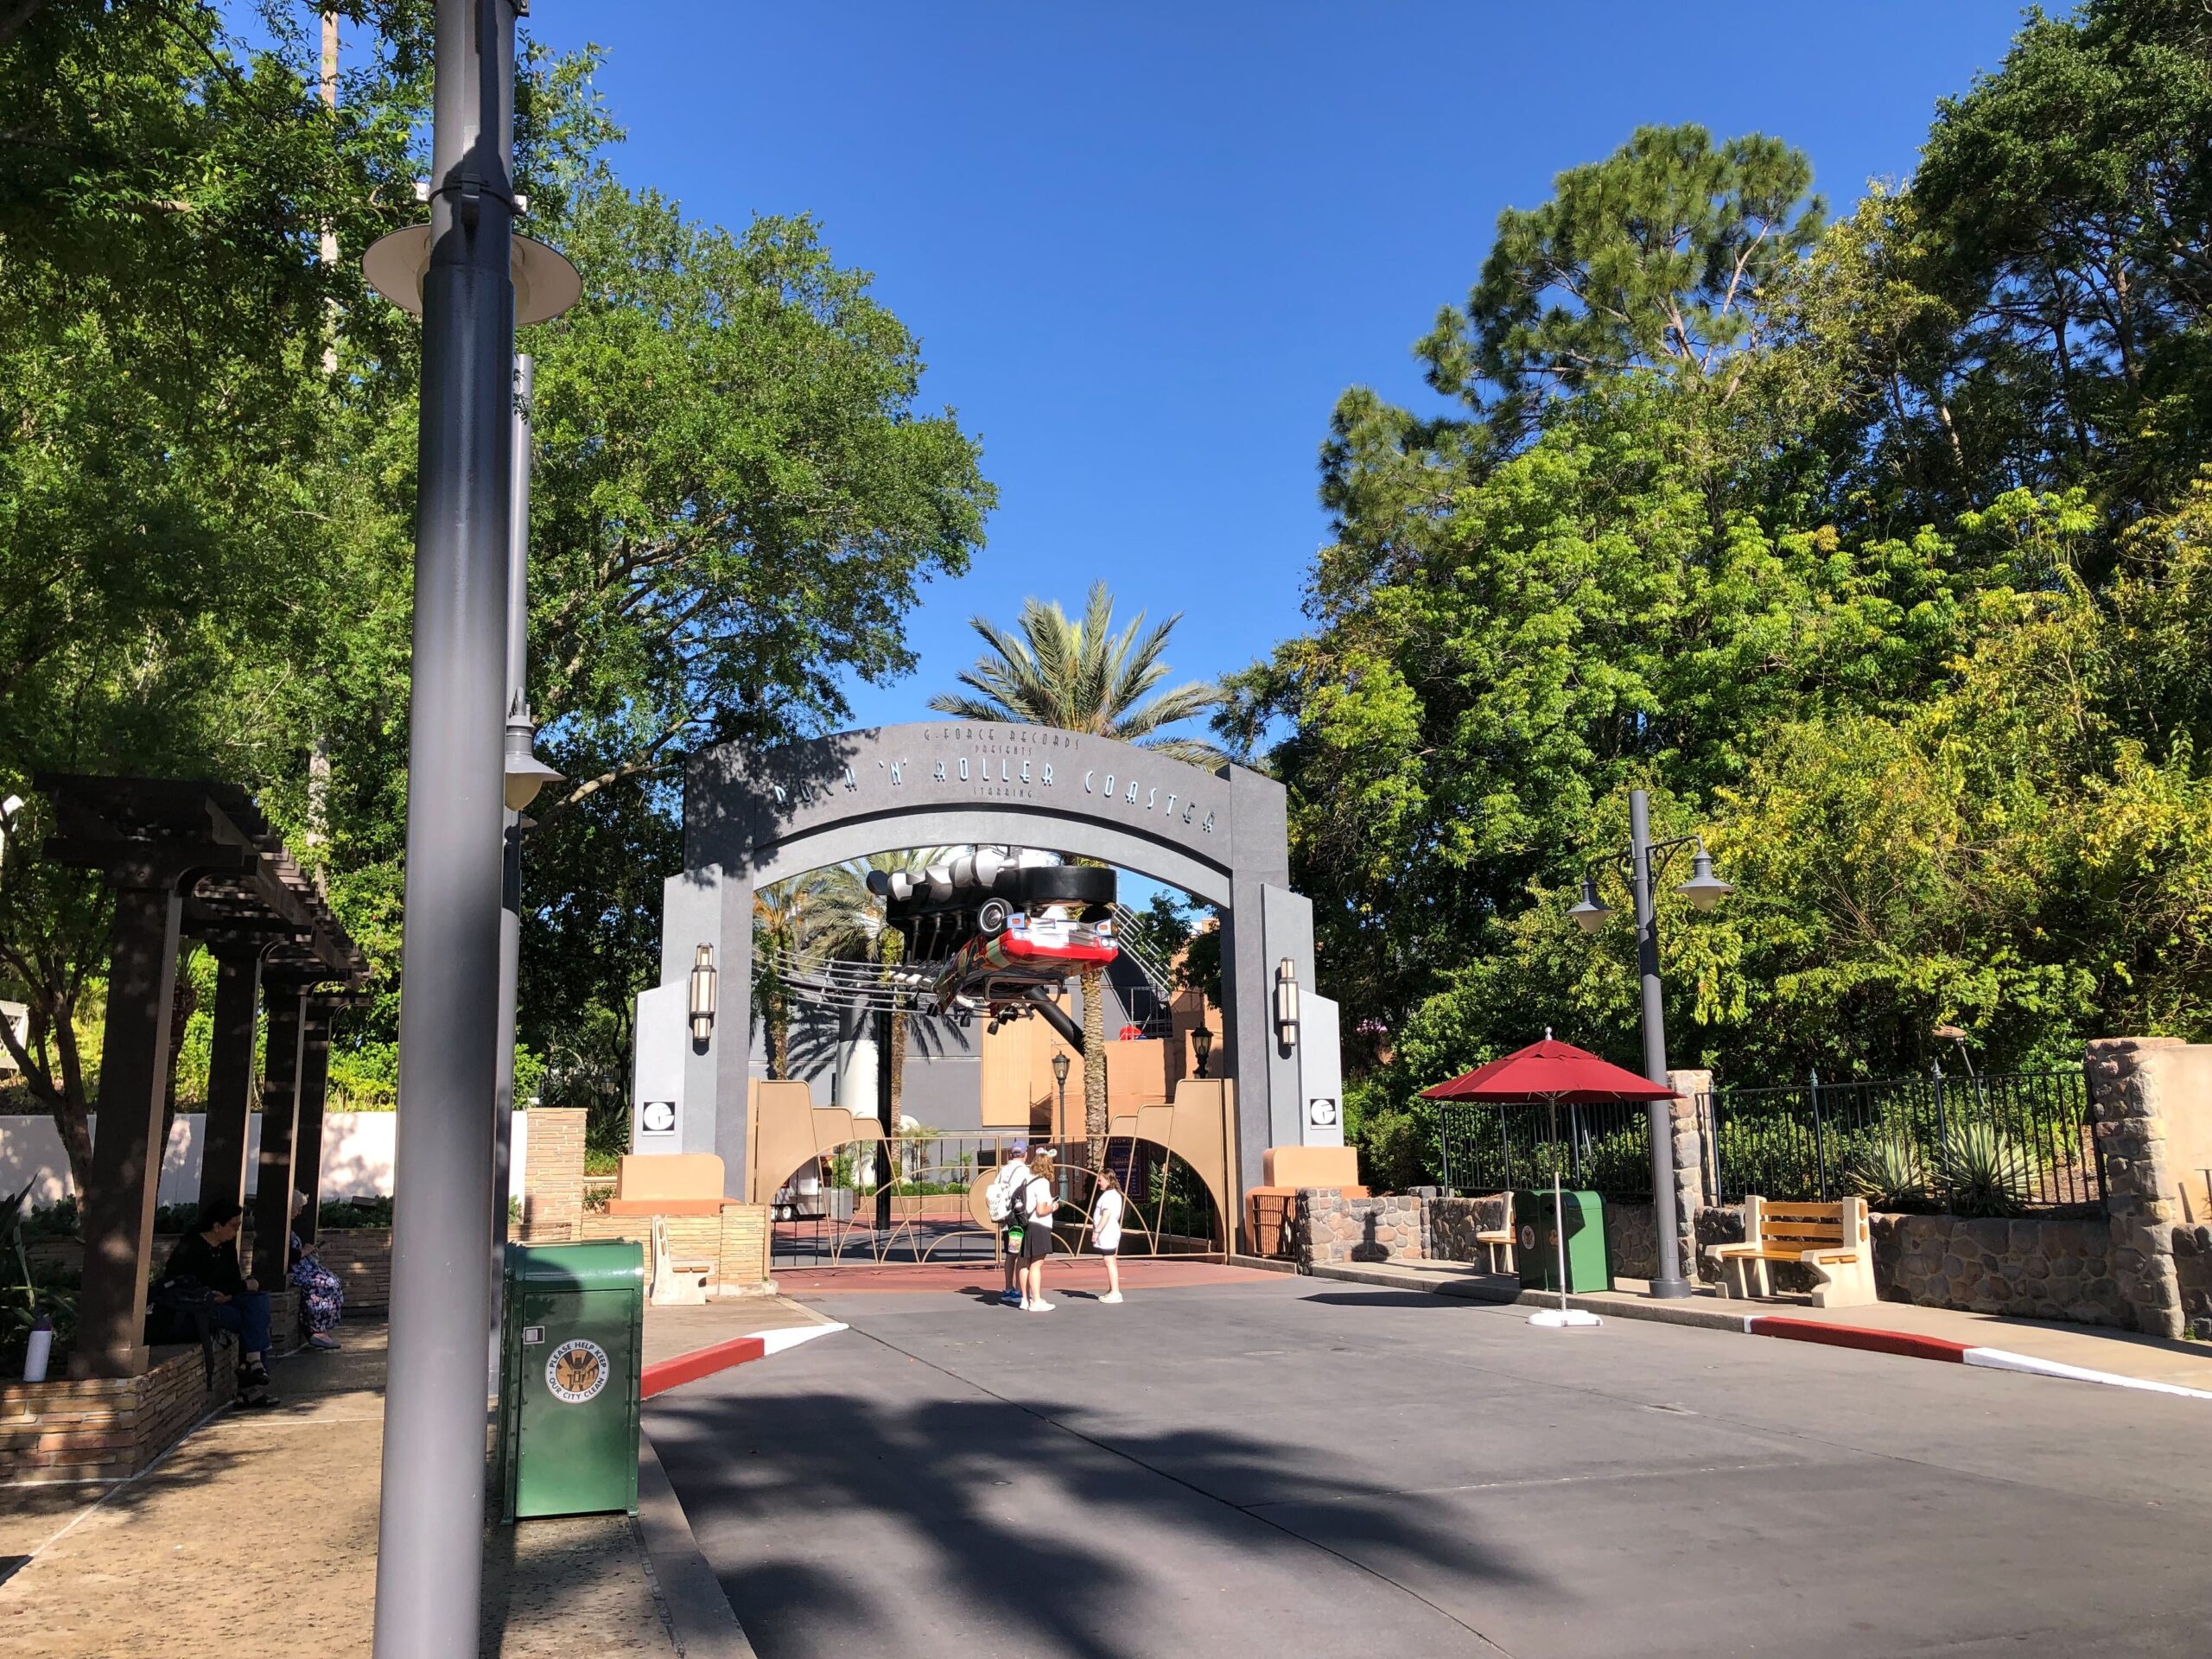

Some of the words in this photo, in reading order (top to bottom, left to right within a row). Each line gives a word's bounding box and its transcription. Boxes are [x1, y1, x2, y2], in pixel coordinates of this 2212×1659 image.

[925, 728, 994, 741] G-FORCE
[1010, 730, 1079, 749] RECORDS
[975, 745, 1032, 755] PRESENTS
[774, 766, 858, 807] ROCK
[934, 757, 1053, 786] ROLLER
[1084, 770, 1216, 832] COASTER
[973, 787, 1032, 798] STARRING
[549, 1343, 572, 1369] PLEASE
[575, 1341, 594, 1350] HELP
[594, 1350, 607, 1368] KEEP
[549, 1377, 562, 1394] OUR
[583, 1377, 605, 1397] CLEAN
